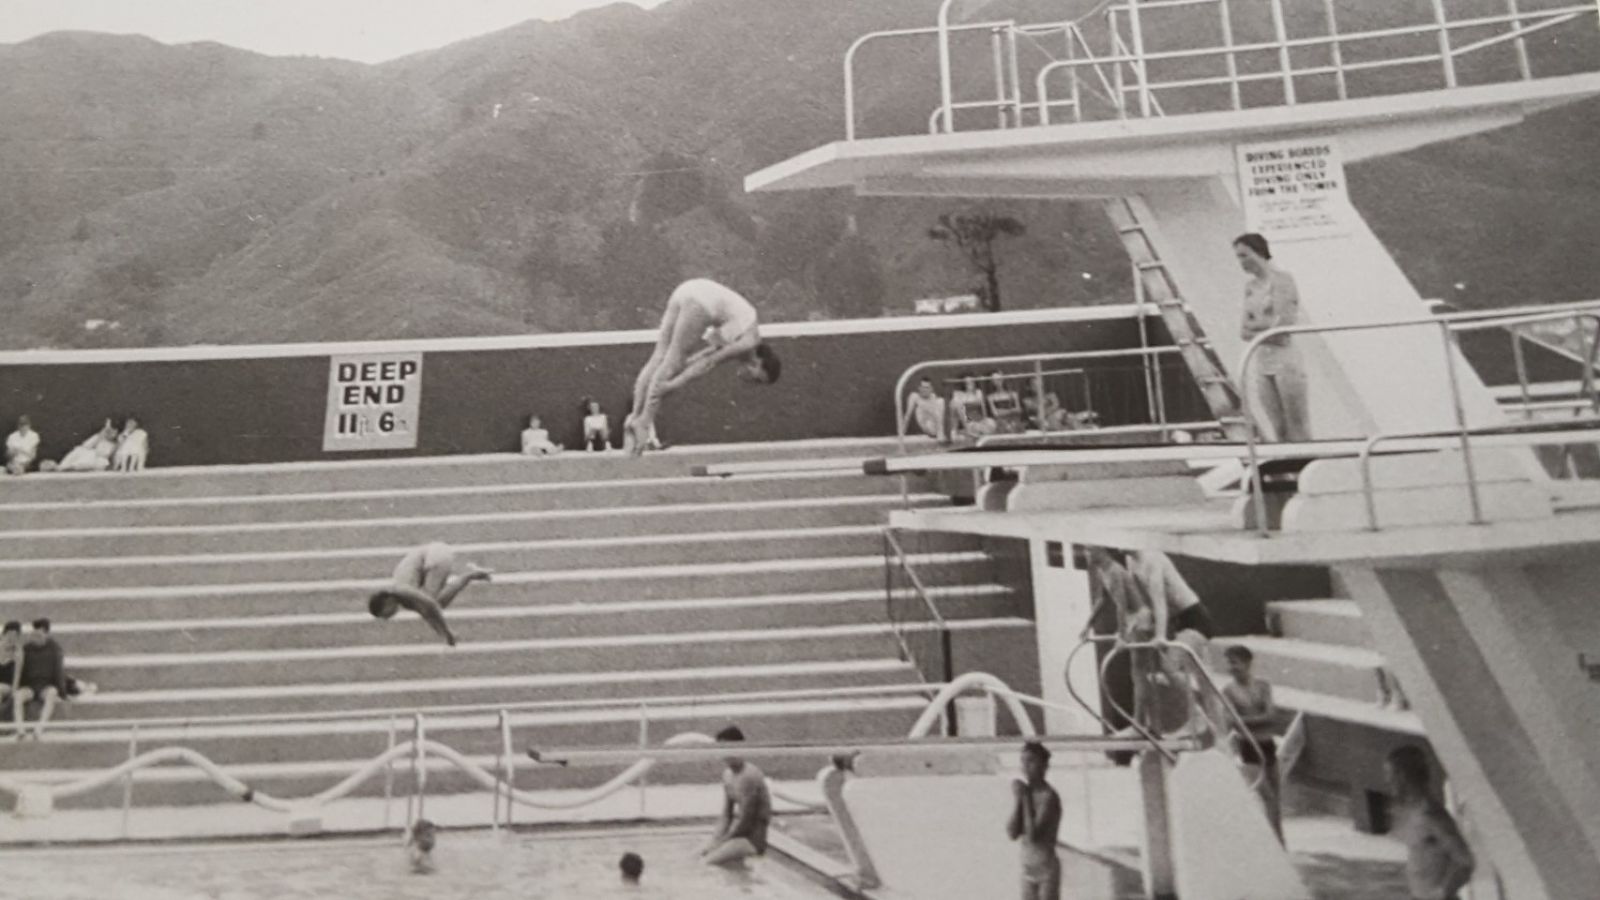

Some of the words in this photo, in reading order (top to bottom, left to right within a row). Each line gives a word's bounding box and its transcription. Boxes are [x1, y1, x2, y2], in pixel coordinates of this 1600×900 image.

[1246, 151, 1284, 162] DIVING
[1288, 146, 1330, 158] BOARDS
[1252, 160, 1326, 174] EXPERIENCED
[1254, 174, 1290, 185] DIVING
[1296, 172, 1325, 181] ONLY
[1249, 187, 1275, 196] FROM
[1280, 184, 1298, 193] THE
[1303, 181, 1337, 192] TOWER
[338, 361, 417, 382] DEEP
[343, 385, 405, 405] END
[379, 411, 395, 433] 6
